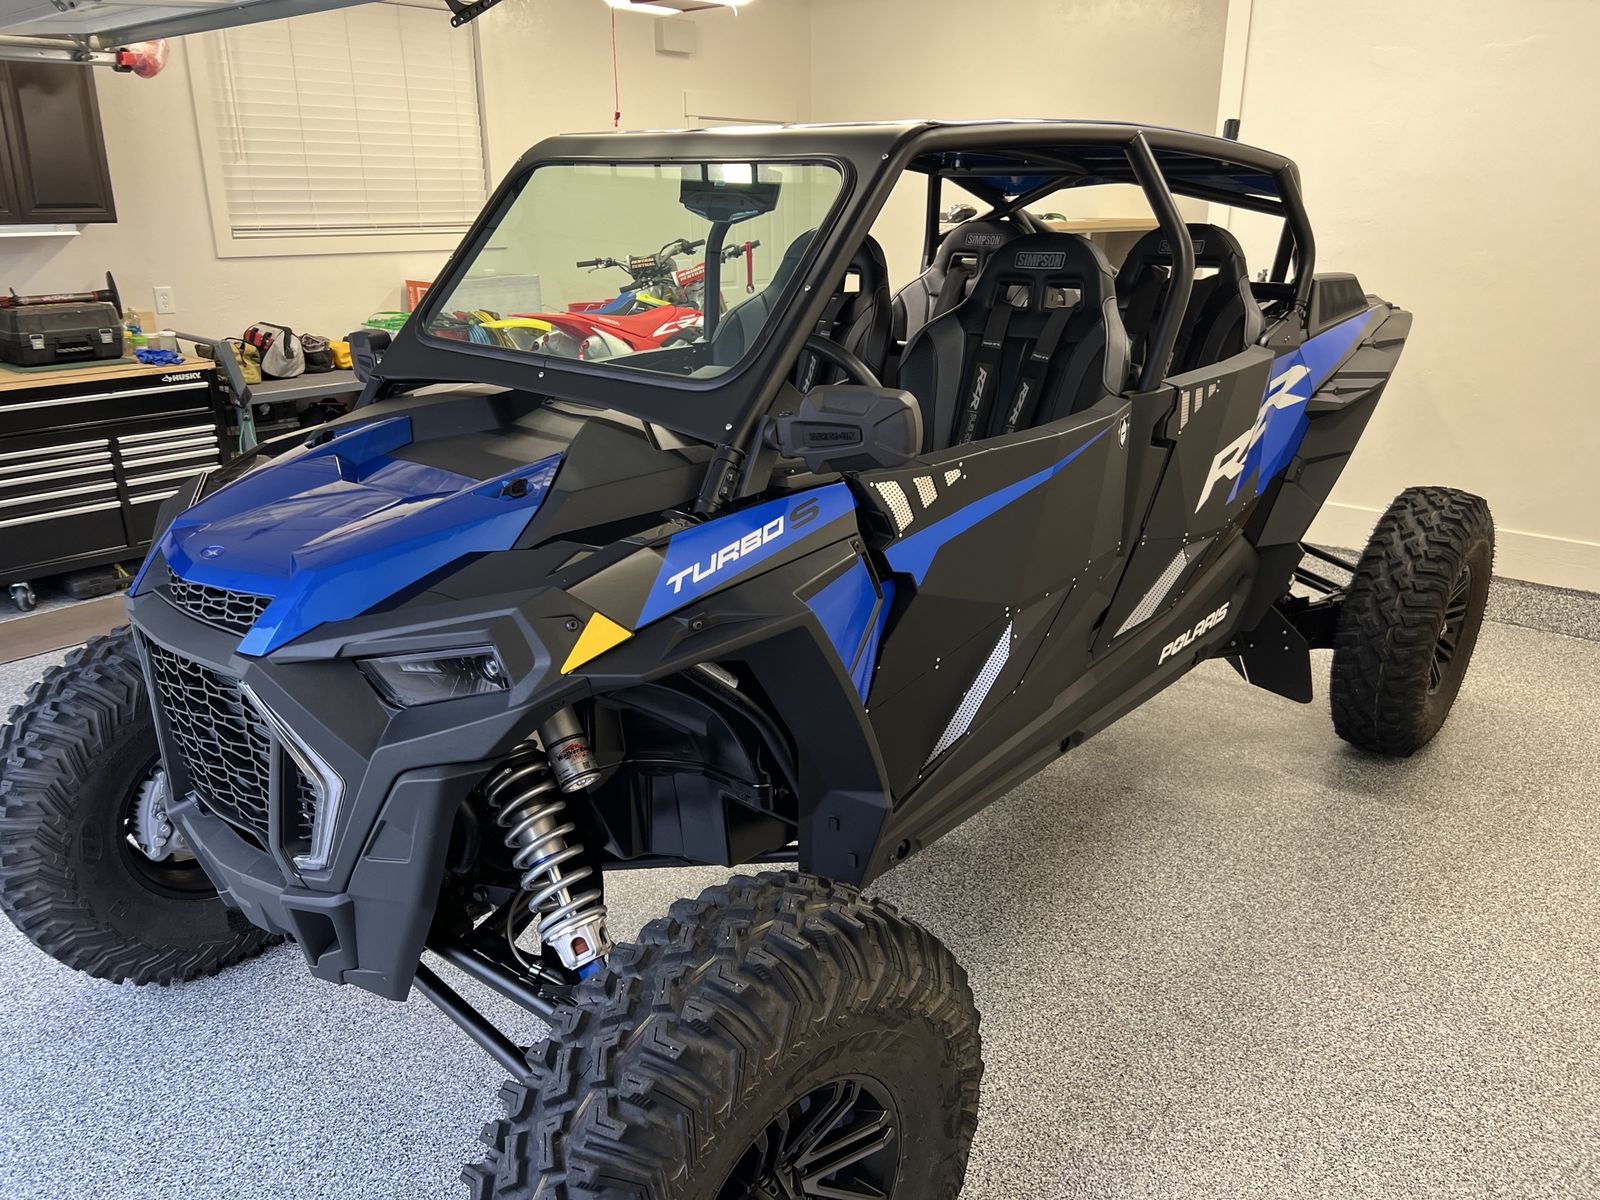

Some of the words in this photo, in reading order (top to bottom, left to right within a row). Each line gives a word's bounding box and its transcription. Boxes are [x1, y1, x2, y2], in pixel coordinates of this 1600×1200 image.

[967, 234, 1001, 246] SIMPSON
[1018, 253, 1063, 267] SIMPSON
[171, 372, 202, 381] HUSKY
[969, 367, 988, 410] RZR
[1008, 381, 1030, 425] RZR
[1194, 364, 1312, 516] RZR
[666, 515, 785, 595] TURBO
[789, 497, 820, 530] S
[1157, 601, 1230, 666] POLARIS
